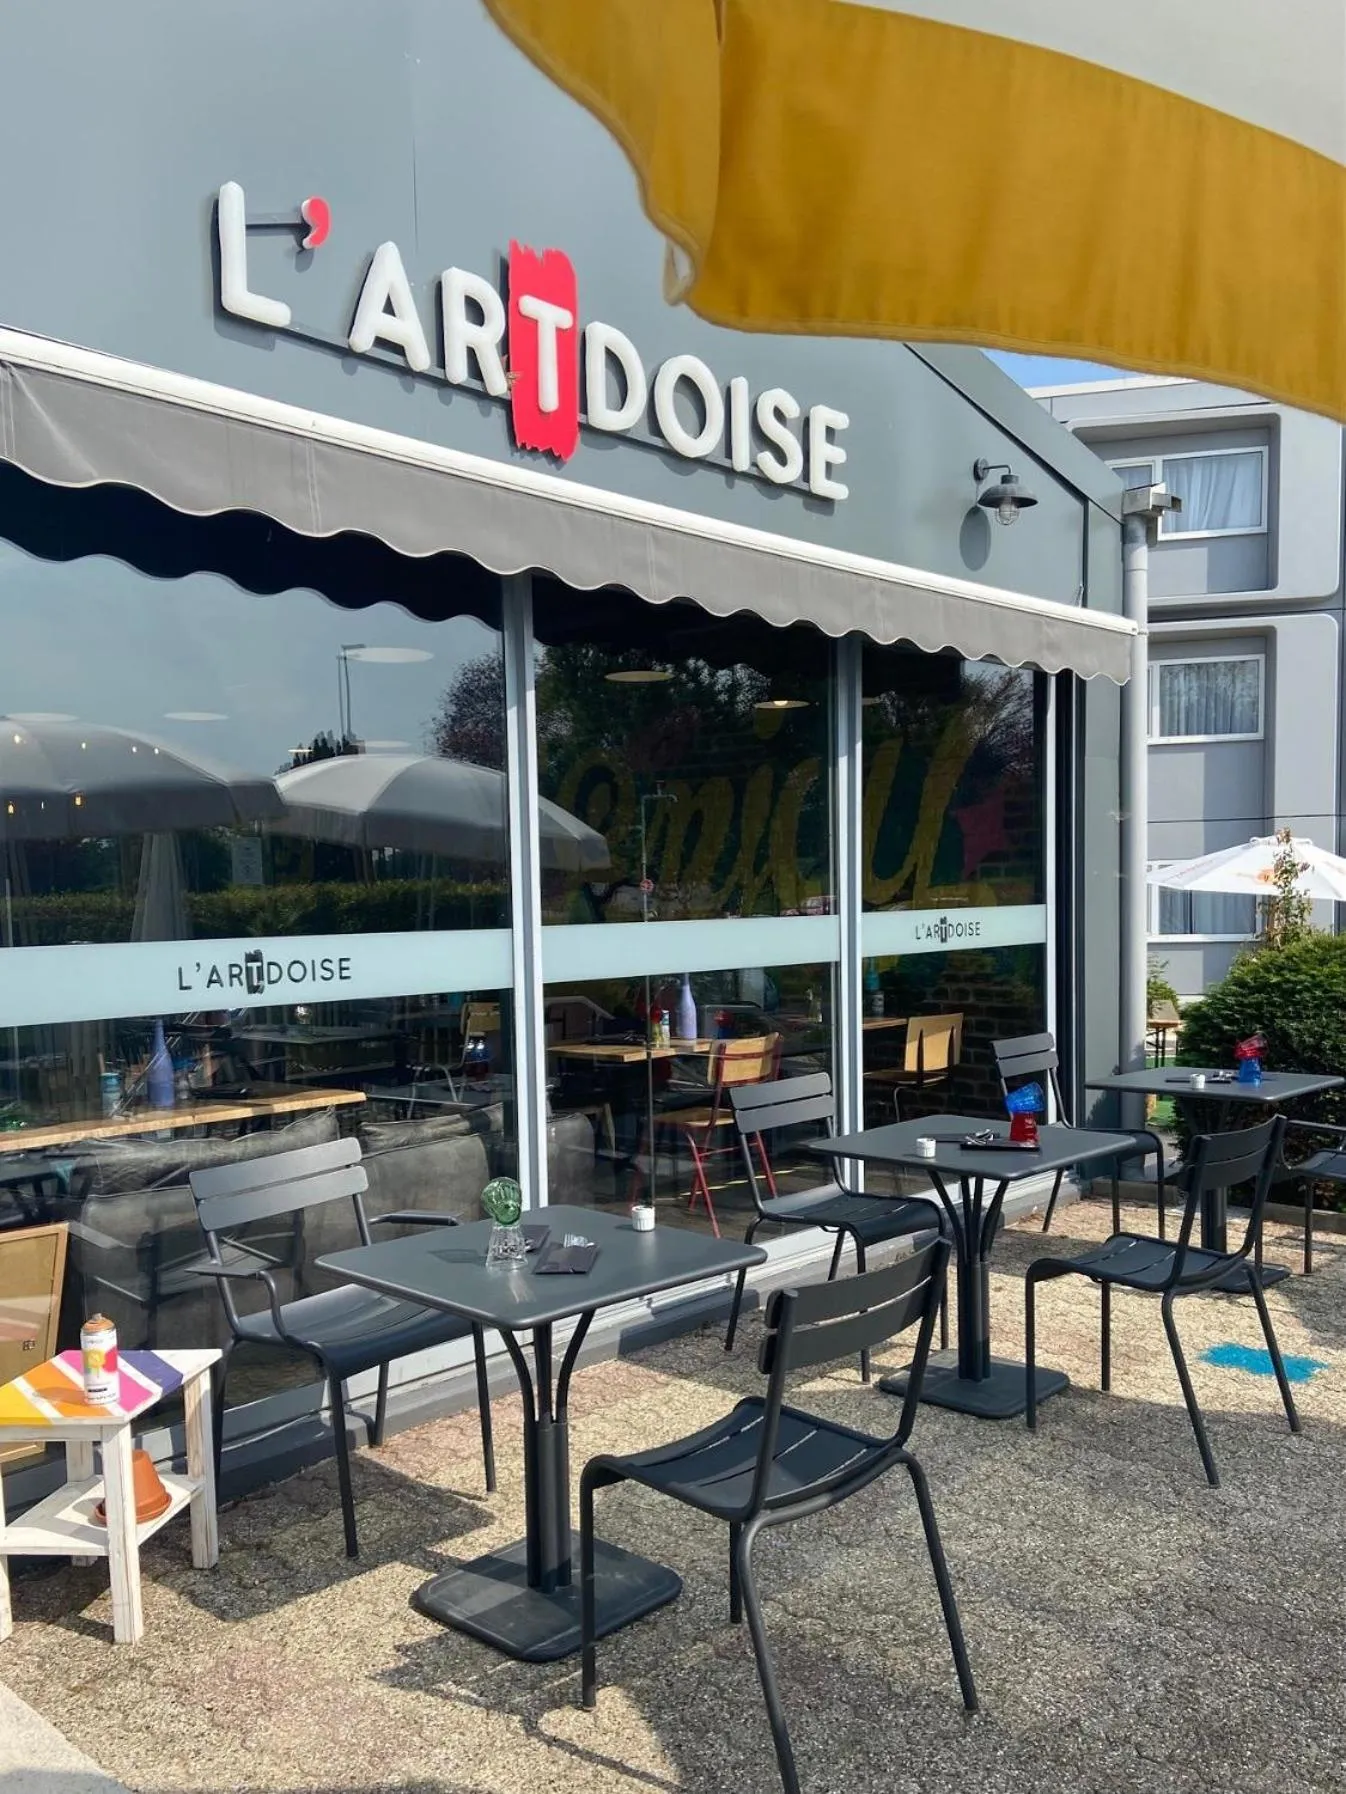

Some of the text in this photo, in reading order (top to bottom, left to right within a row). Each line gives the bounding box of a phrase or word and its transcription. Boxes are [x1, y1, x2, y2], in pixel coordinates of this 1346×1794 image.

[217, 180, 850, 501] L'ARTDOISE
[915, 917, 981, 942] L'ARTDOISE
[178, 949, 352, 994] L'ARTDOISE
